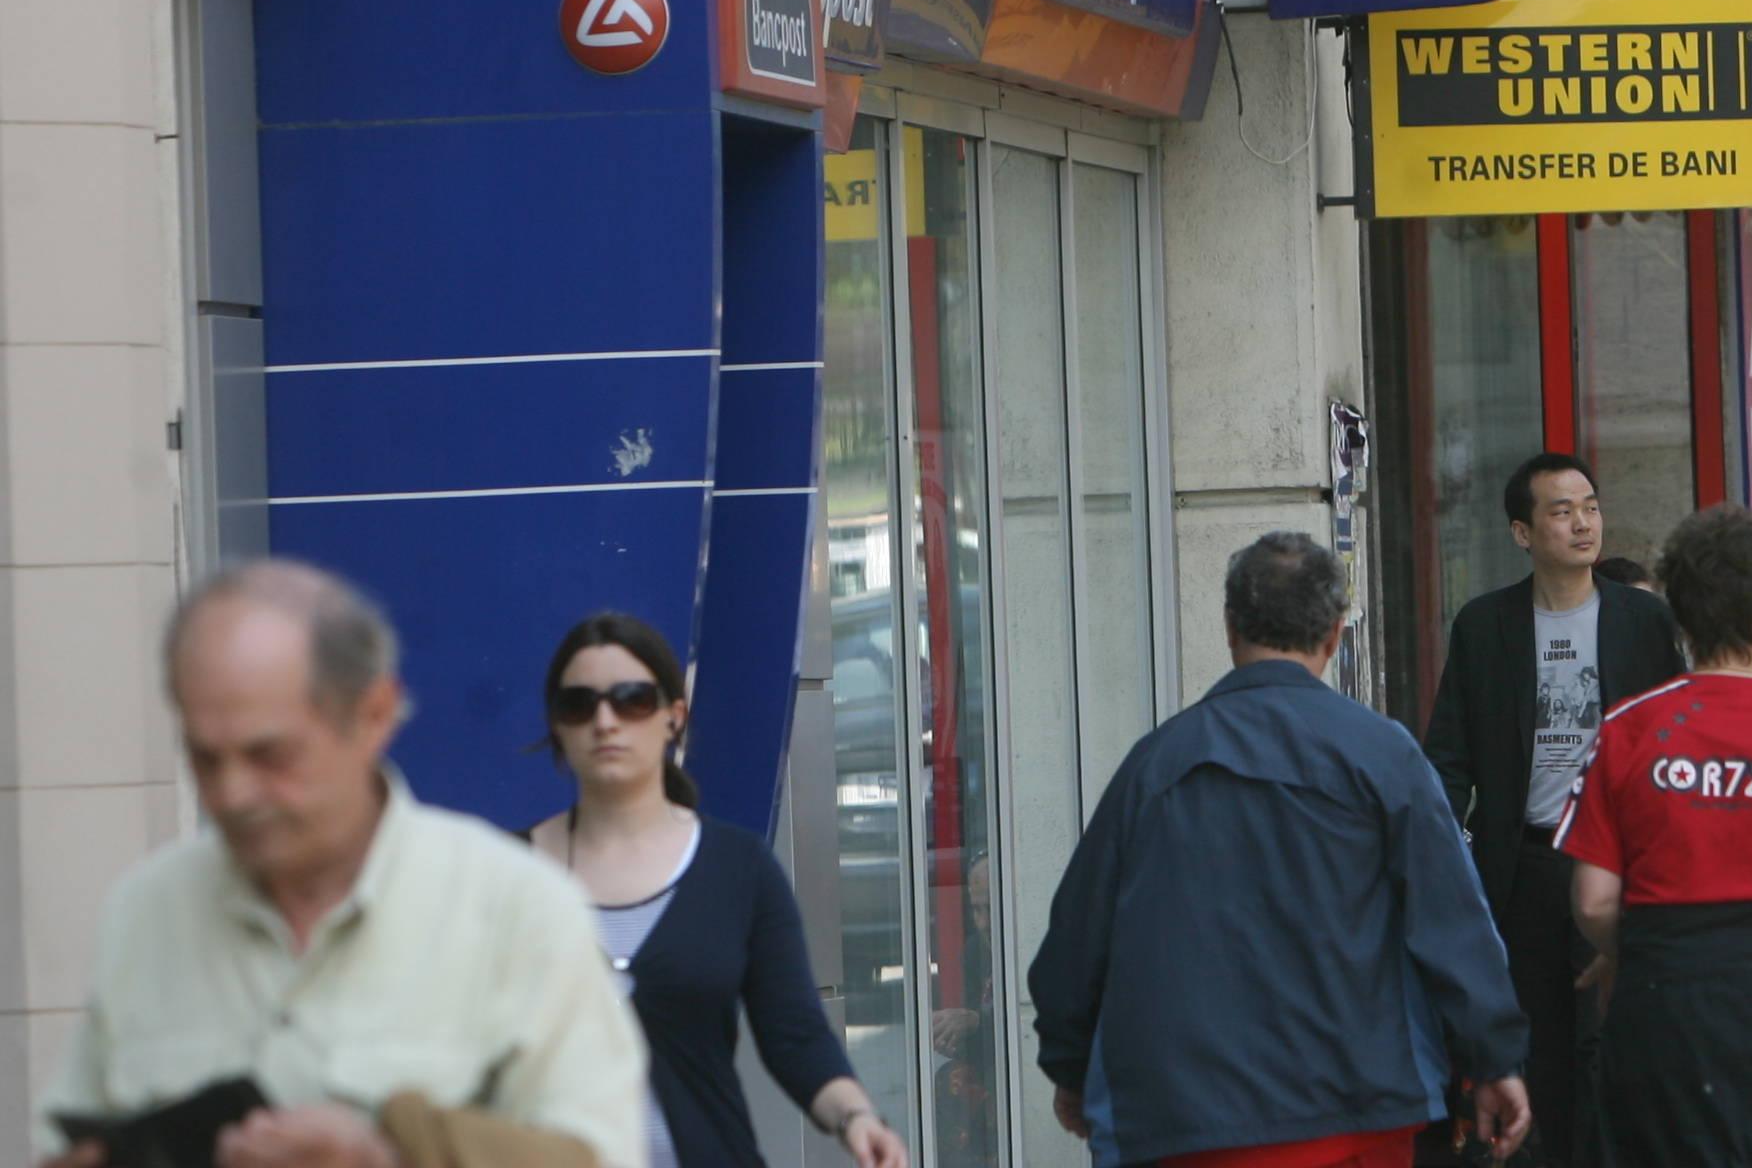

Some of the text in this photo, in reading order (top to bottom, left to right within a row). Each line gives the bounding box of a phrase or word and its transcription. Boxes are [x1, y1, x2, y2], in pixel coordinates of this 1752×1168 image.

[1401, 32, 1701, 76] WESTERN
[1497, 75, 1701, 117] UNION
[1428, 149, 1738, 183] TRANSFER DE BANI
[1543, 650, 1577, 661] LONDON
[1550, 639, 1571, 650] 1980
